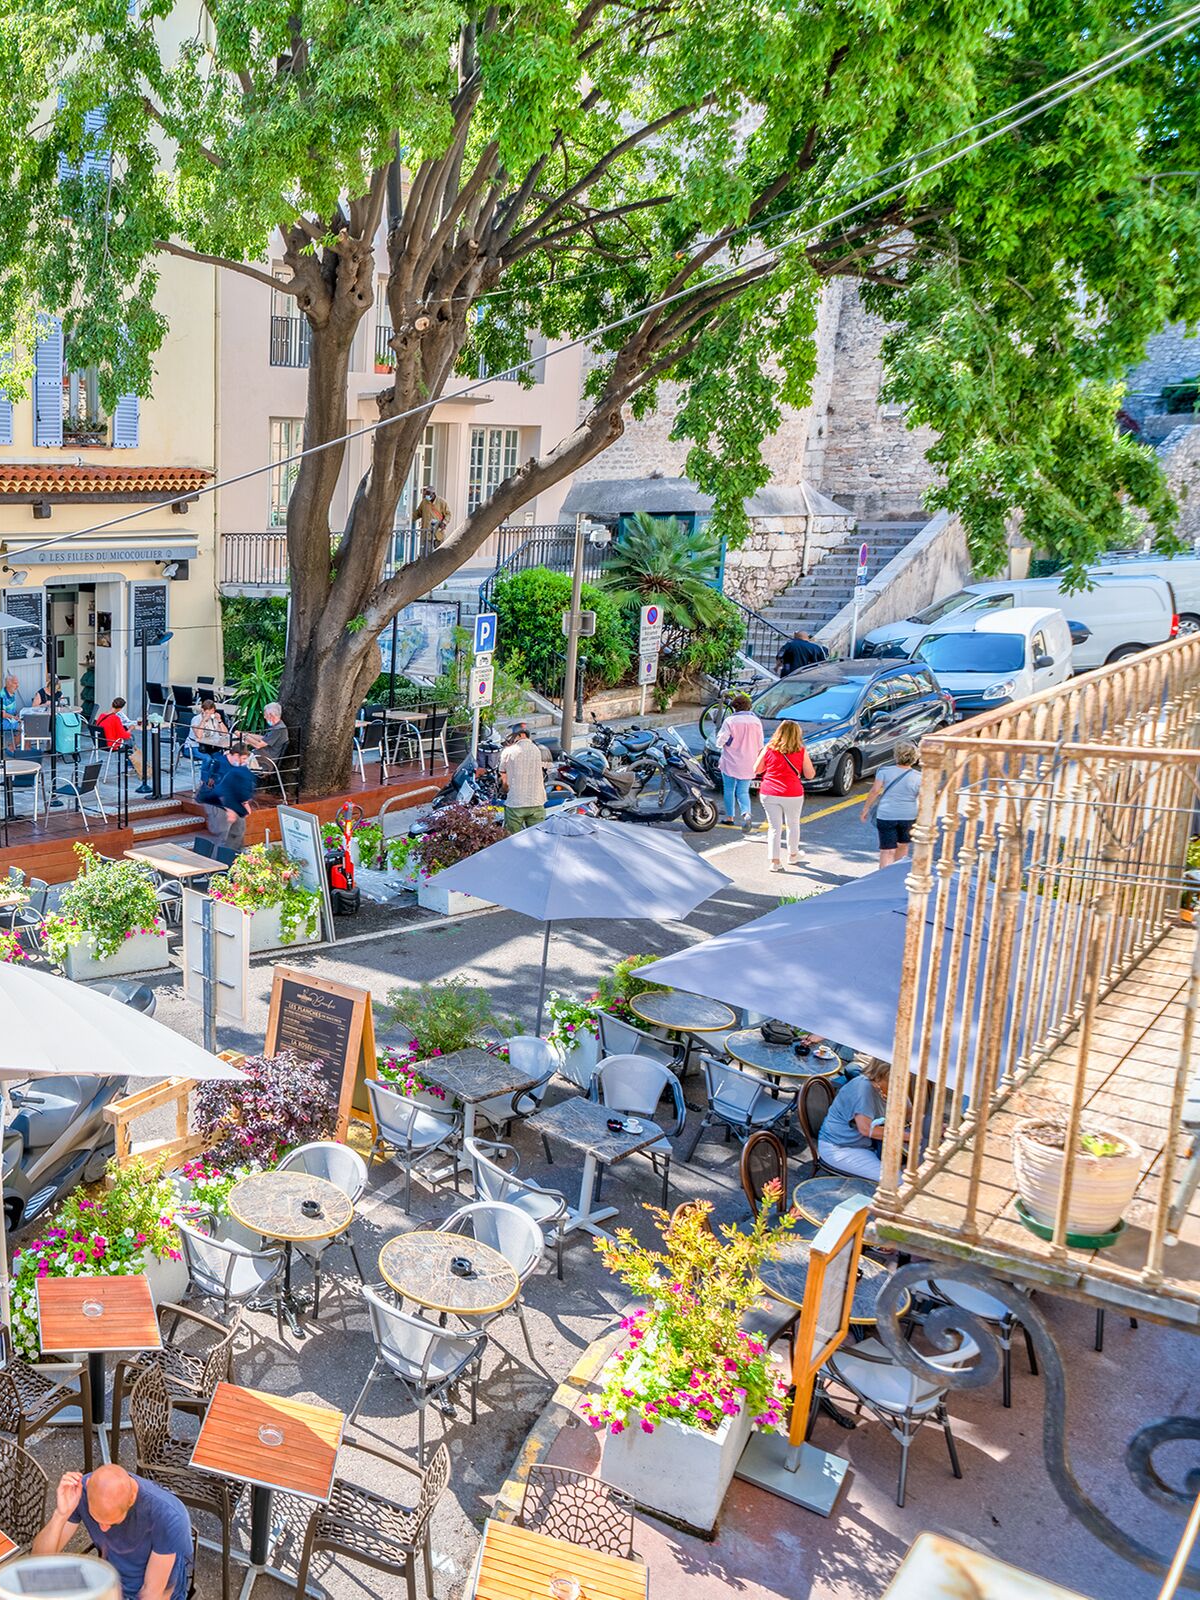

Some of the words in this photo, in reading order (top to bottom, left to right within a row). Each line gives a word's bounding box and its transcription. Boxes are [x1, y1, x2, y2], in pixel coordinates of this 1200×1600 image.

[49, 552, 65, 562] LES
[67, 551, 94, 562] FILLES
[96, 551, 108, 561] DU
[110, 549, 163, 560] MICOCOULIER
[480, 622, 490, 646] P
